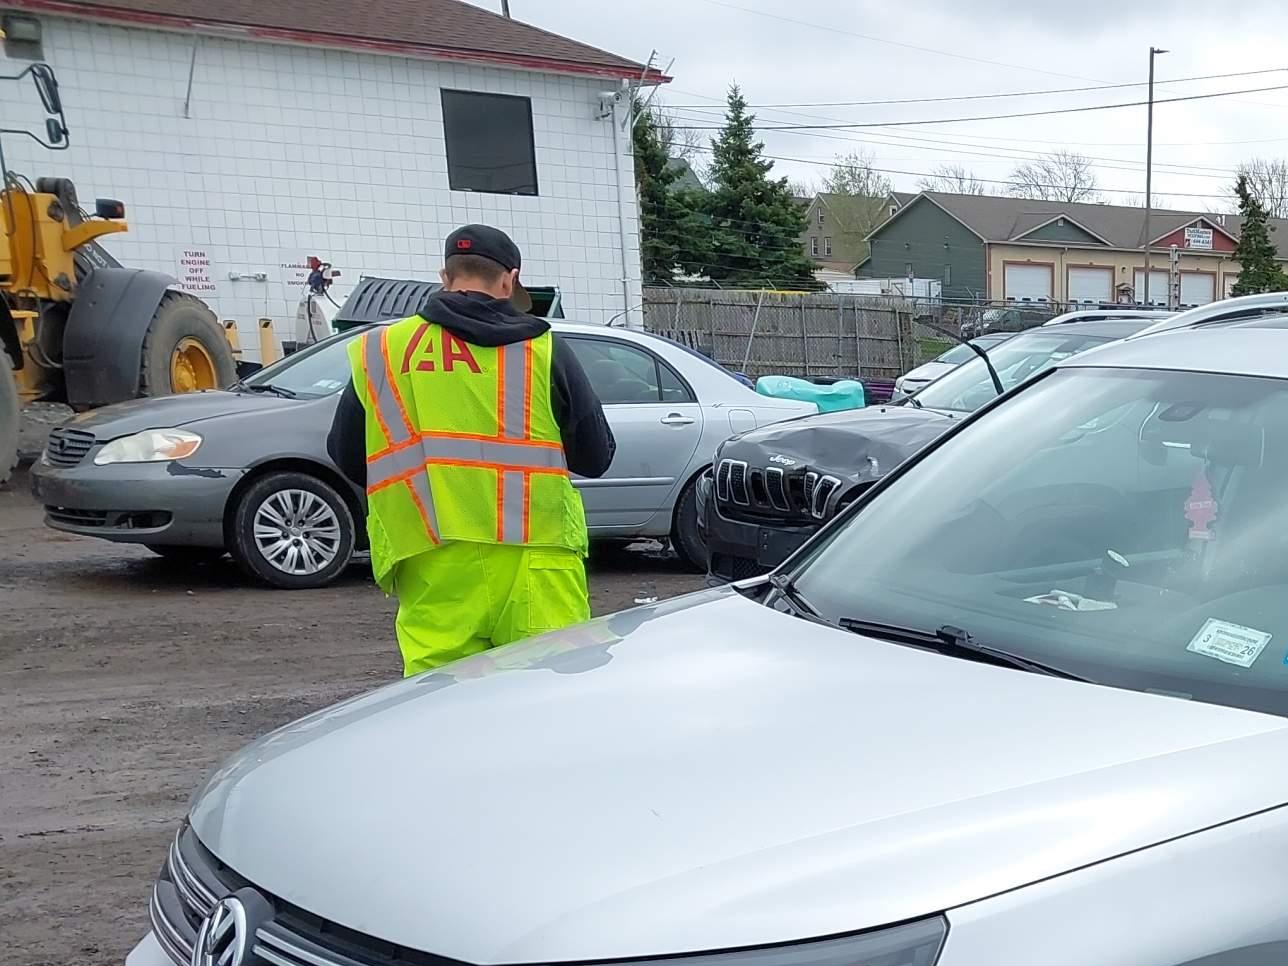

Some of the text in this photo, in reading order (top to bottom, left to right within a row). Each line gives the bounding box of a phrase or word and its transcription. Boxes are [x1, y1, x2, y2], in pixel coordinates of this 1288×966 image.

[769, 455, 796, 466] Jeep
[1202, 634, 1212, 644] 3
[1240, 645, 1256, 656] 26
